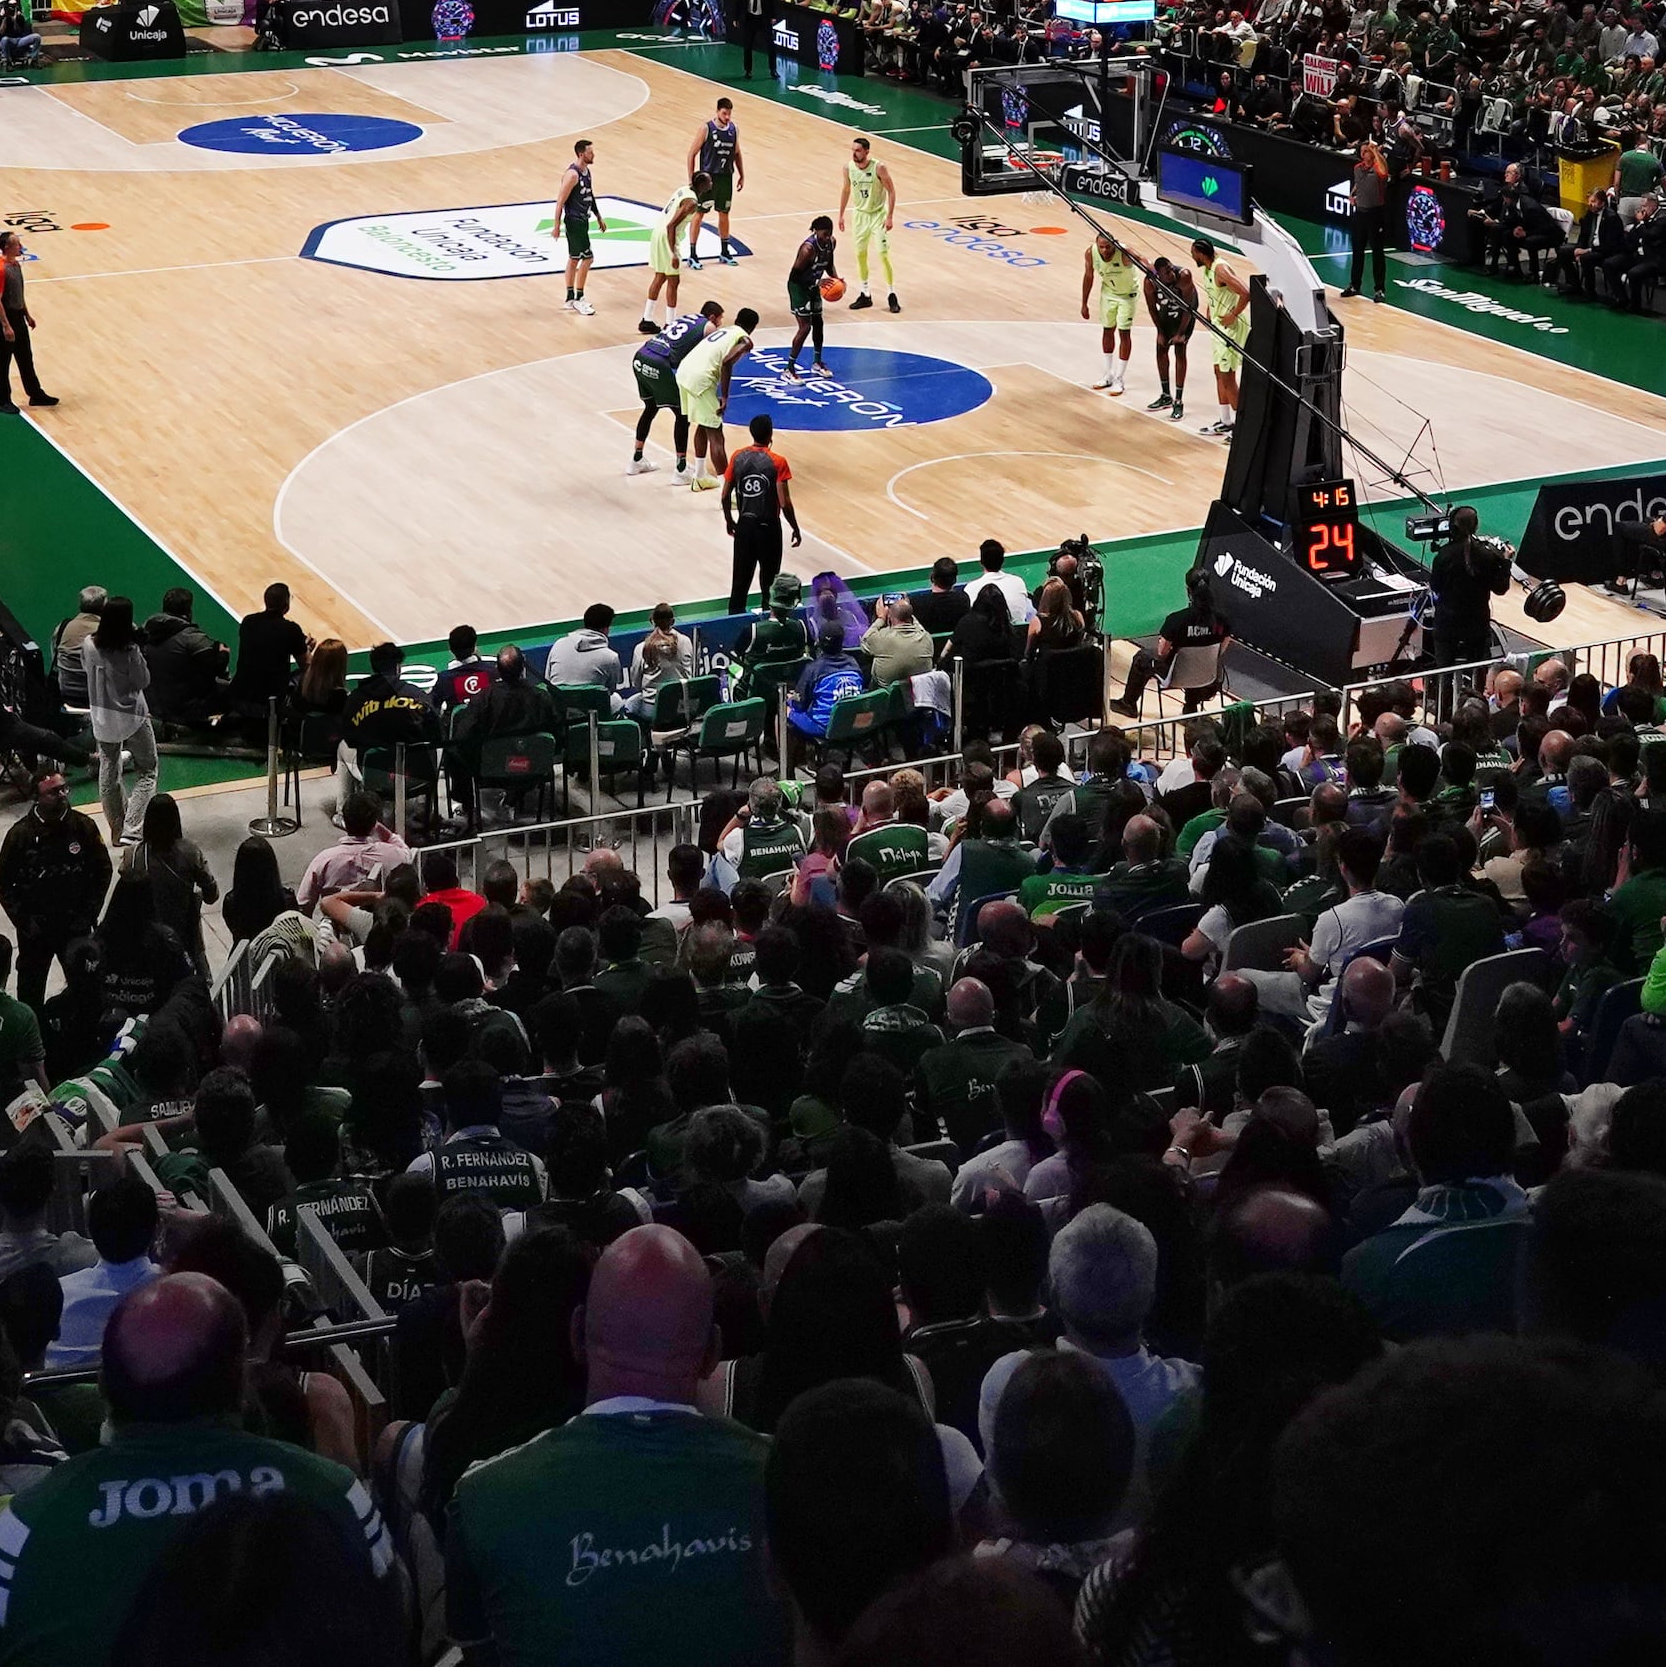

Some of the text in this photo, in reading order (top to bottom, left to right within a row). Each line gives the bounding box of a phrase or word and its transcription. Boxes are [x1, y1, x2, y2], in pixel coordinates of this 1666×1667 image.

[292, 2, 390, 30] endesa
[525, 9, 580, 27] LOTUS
[129, 29, 168, 42] Unicaja
[397, 44, 520, 60] Movistar
[720, 157, 727, 170] 7
[860, 189, 869, 199] 13
[1076, 174, 1127, 200] endesa
[949, 214, 1028, 238] liga
[357, 224, 457, 271] Baloncesto
[412, 227, 486, 262] Unicaja
[442, 218, 549, 264] Fundación
[903, 220, 1050, 269] endesa
[744, 478, 762, 493] 68
[1313, 486, 1350, 509] 4:15
[1309, 523, 1355, 571] 24
[1232, 574, 1264, 600] Unicaja
[1234, 559, 1277, 592] Fundación
[441, 1156, 454, 1170] R.
[565, 1524, 753, 1588] Benahavís
